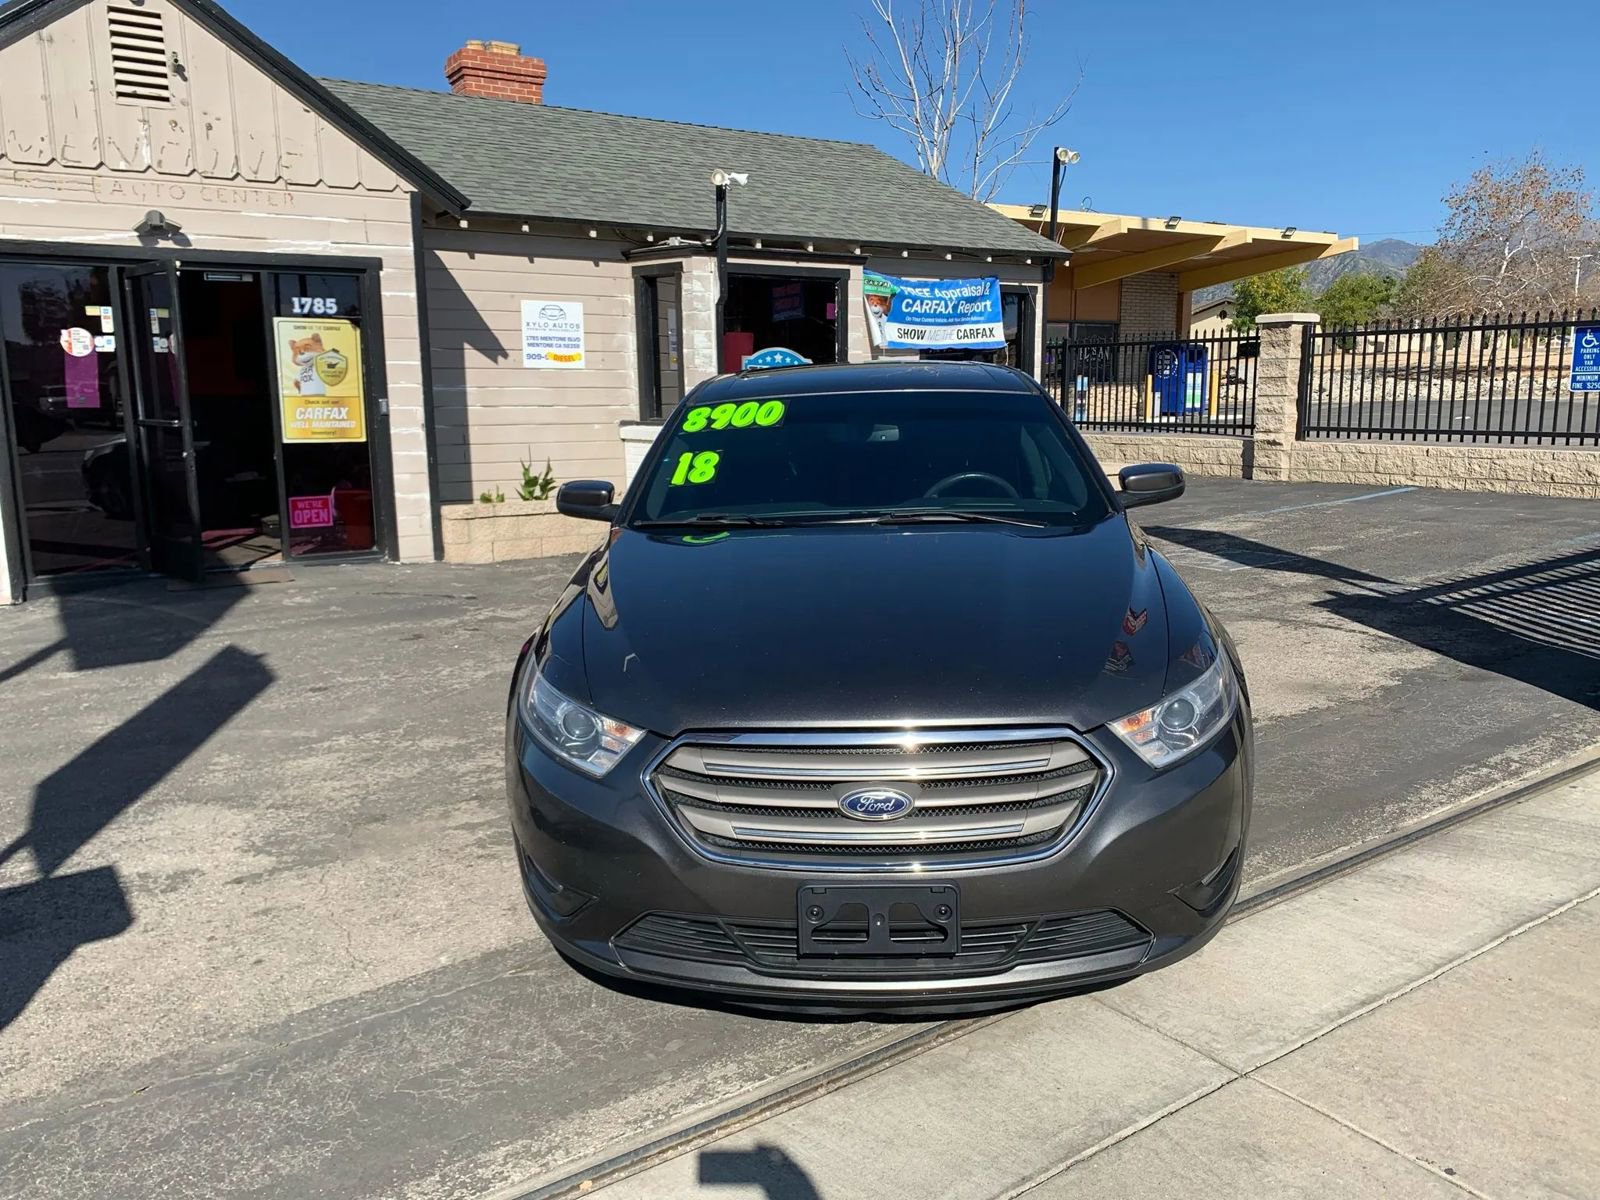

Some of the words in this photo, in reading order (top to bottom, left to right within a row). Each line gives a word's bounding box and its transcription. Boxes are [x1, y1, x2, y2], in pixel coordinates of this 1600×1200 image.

[934, 282, 984, 300] Appraisal
[984, 282, 991, 296] &
[291, 297, 338, 315] 1785
[957, 299, 992, 316] Report
[897, 328, 927, 341] SHOW
[927, 329, 941, 341] ME
[956, 327, 996, 341] CARFAX
[1576, 374, 1599, 382] MINIMUM
[295, 407, 349, 420] CARFAX
[682, 400, 785, 433] 8900
[671, 451, 720, 485] 18
[294, 508, 329, 524] OPEN
[857, 795, 896, 812] Ford
